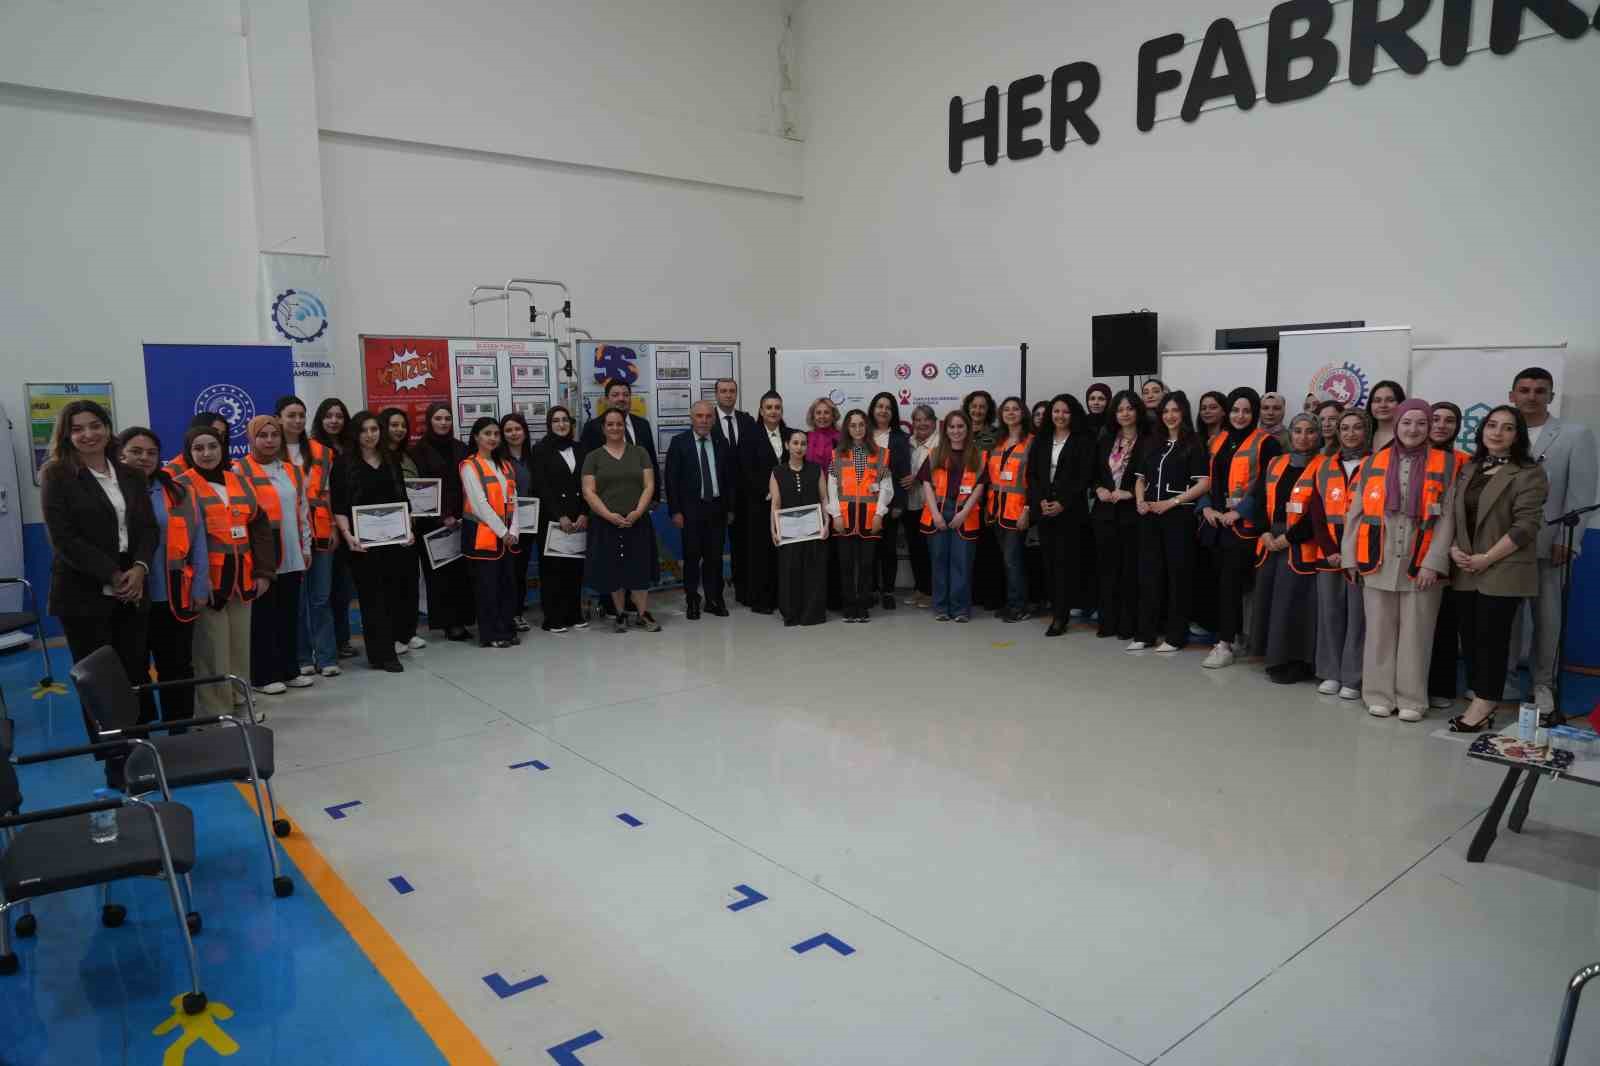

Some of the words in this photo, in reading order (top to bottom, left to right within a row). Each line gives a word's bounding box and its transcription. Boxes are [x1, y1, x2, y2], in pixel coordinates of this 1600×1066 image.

[949, 61, 1101, 173] HER
[1136, 0, 1600, 132] FABRIK
[964, 363, 985, 375] OKA
